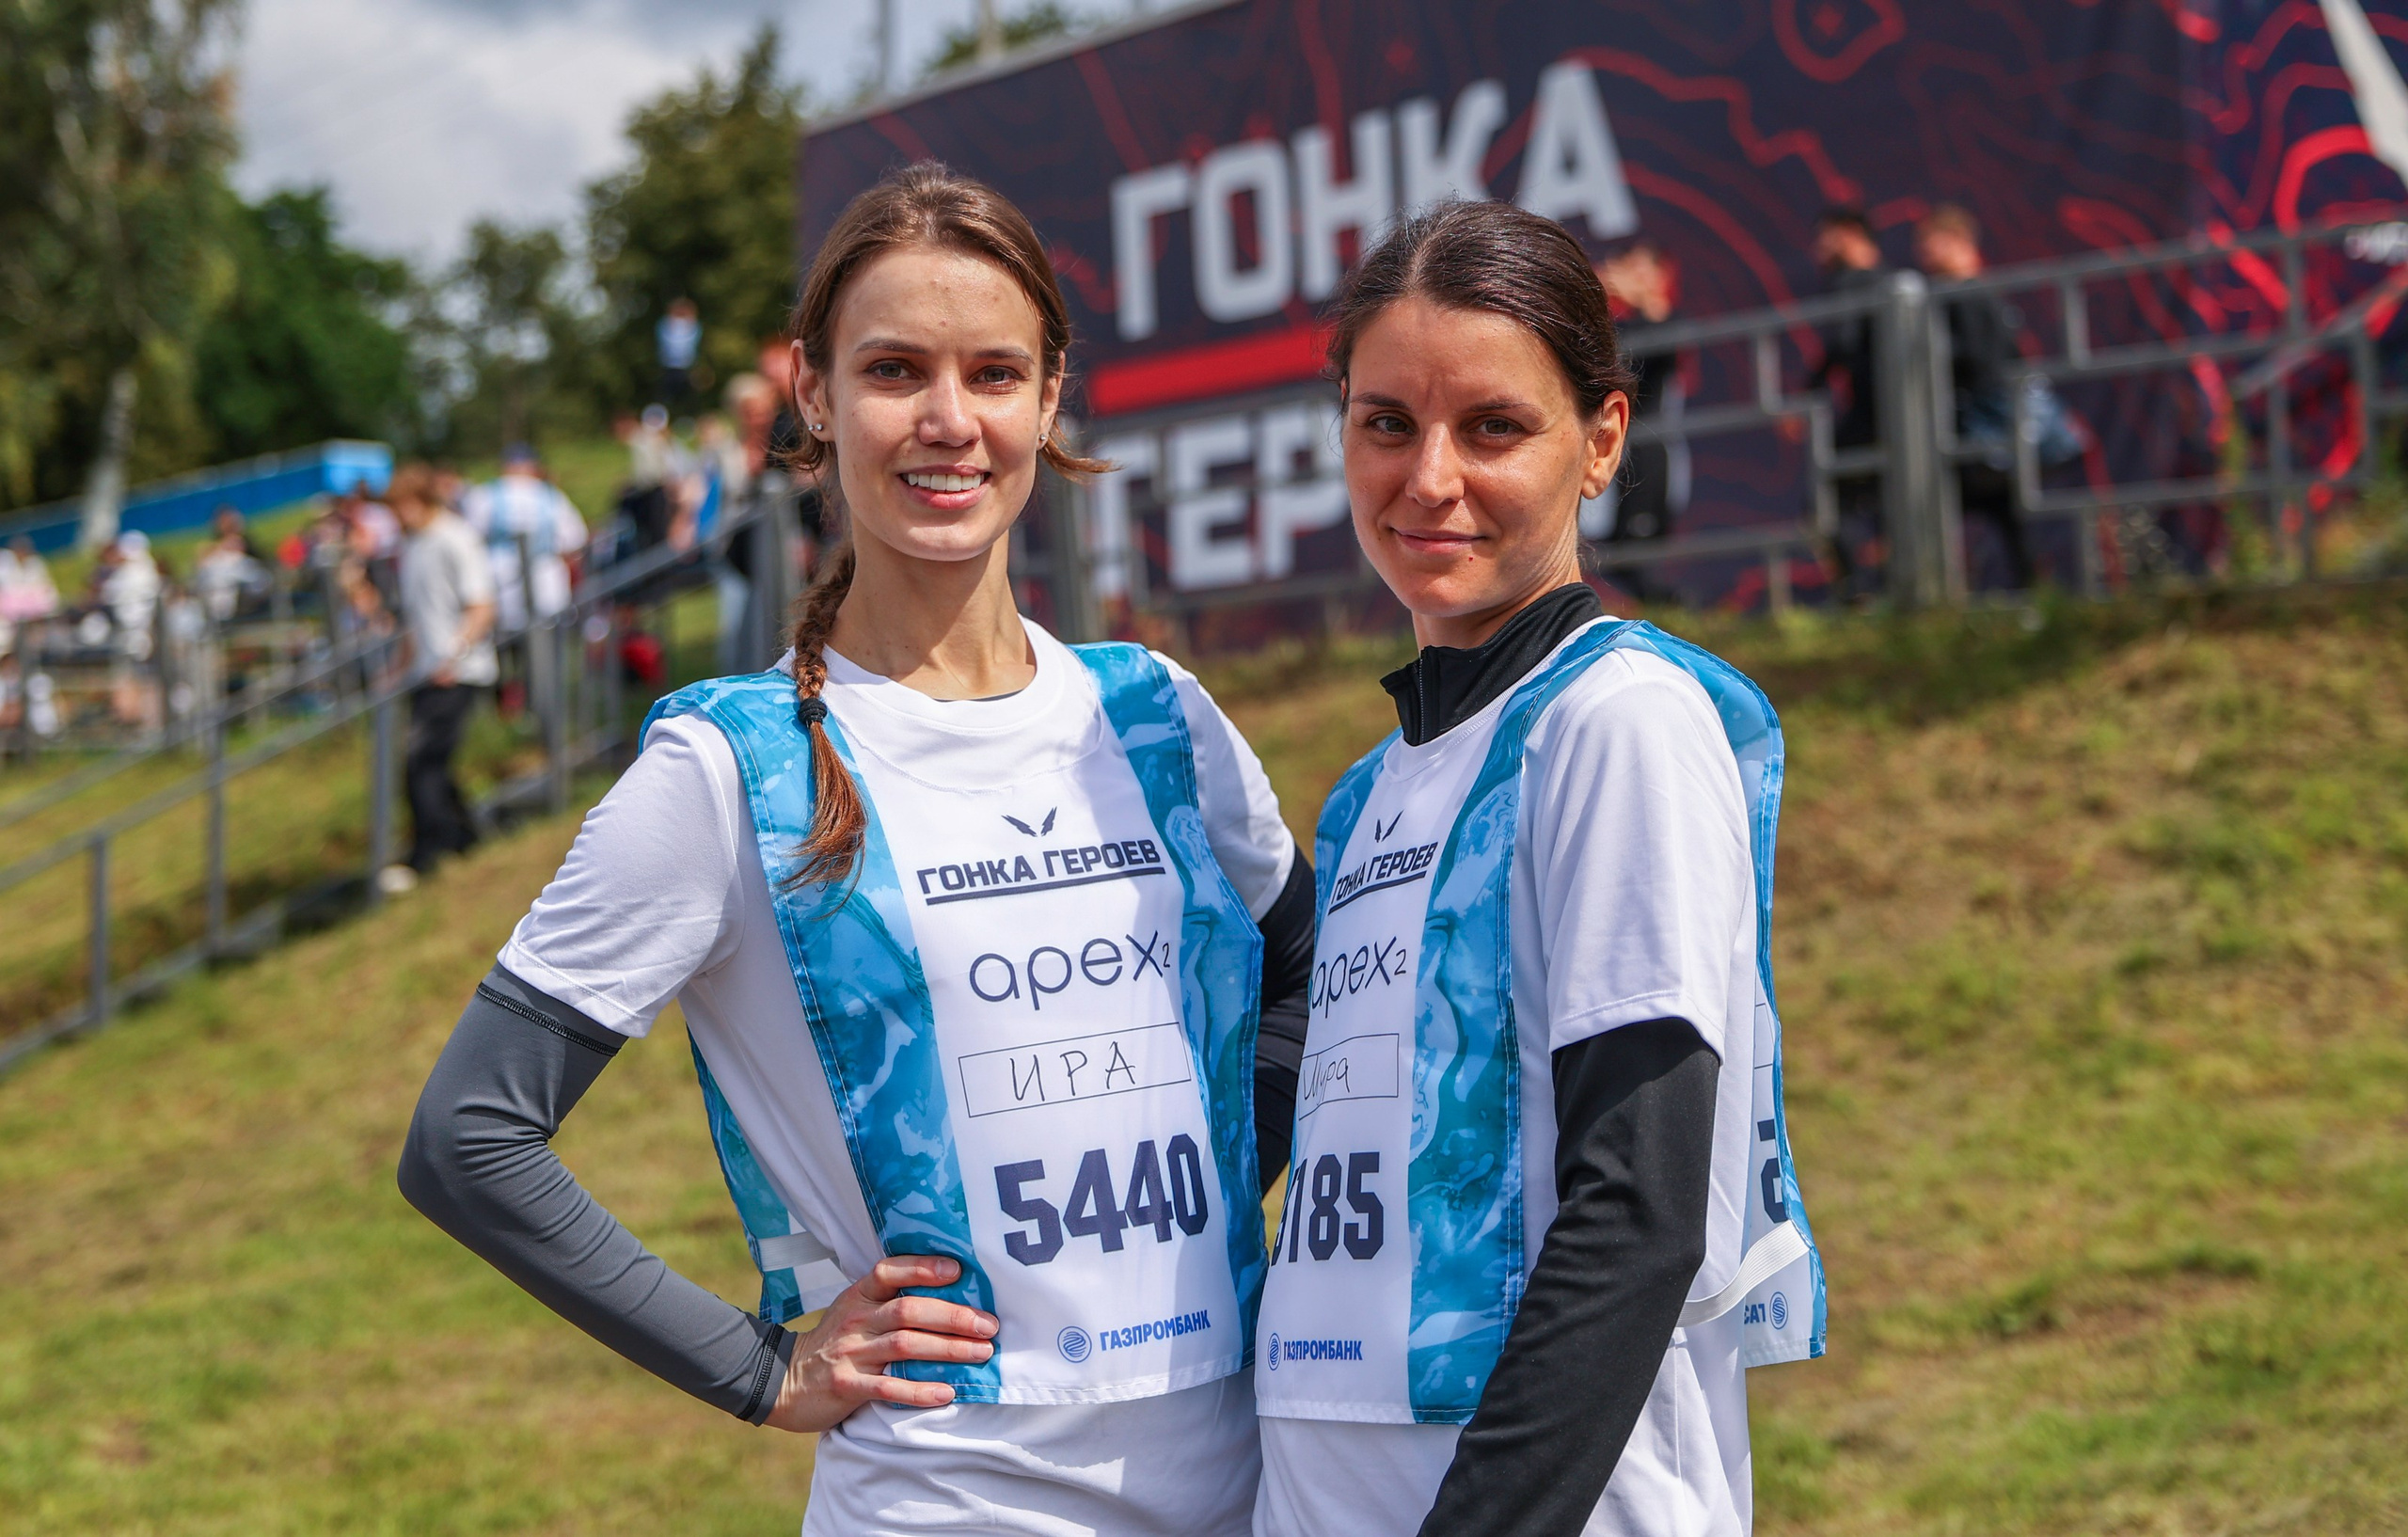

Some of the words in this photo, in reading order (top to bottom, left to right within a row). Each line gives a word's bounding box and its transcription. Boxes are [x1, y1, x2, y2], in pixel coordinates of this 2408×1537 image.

[1110, 60, 1640, 343] ГОНКА
[1089, 403, 1353, 596] ГЕР
[916, 854, 1038, 895] ГОНКА
[1042, 838, 1162, 878] ГЕРОЕВ
[1330, 862, 1367, 905] ГОНКА
[1367, 841, 1439, 883] ГЕРОЕВ
[1009, 1040, 1136, 1102] ИРА
[993, 1133, 1210, 1267] 5440
[1100, 1308, 1212, 1352] ГАЗПРОМБАНК
[1283, 1339, 1364, 1362] ГАЗПРОМБАНК
